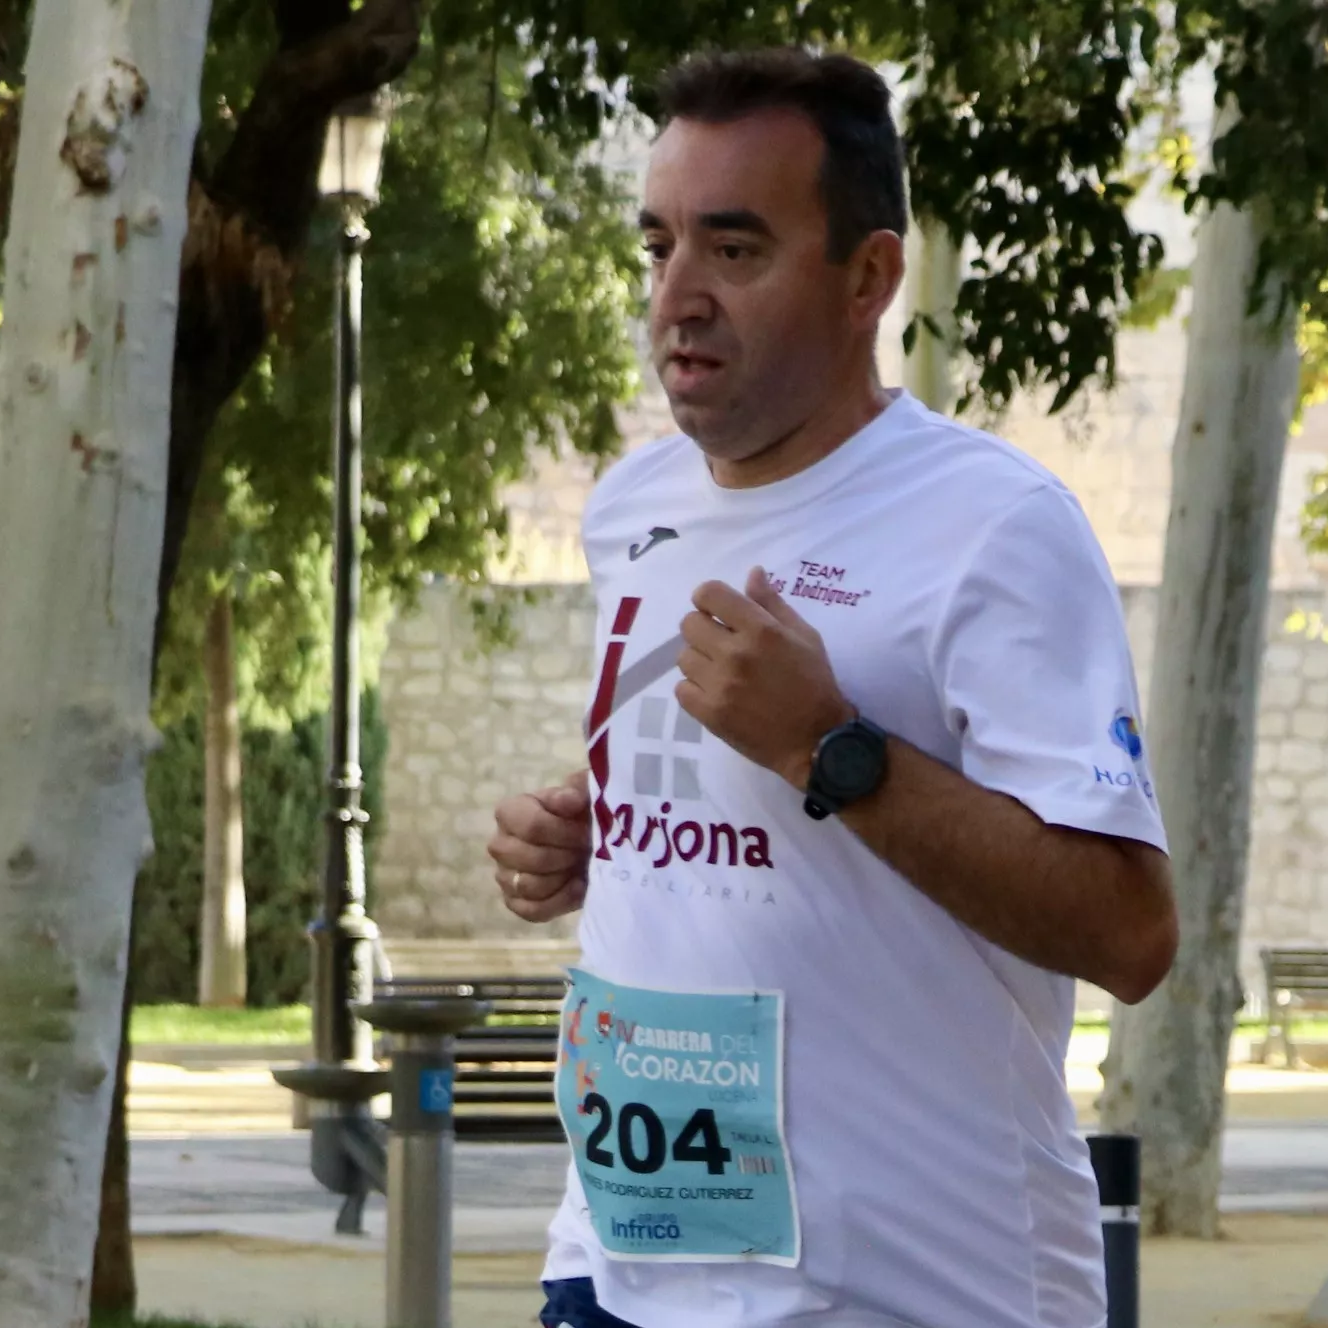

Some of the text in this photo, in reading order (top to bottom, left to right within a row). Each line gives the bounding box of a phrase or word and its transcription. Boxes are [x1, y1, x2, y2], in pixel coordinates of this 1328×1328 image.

[800, 560, 846, 581] TEAM
[634, 1025, 712, 1053] CARRERA
[720, 1034, 758, 1055] DEL
[622, 1051, 760, 1087] CORAZÓN
[583, 1092, 732, 1175] 204
[605, 1181, 675, 1200] RODRIGUEZ
[678, 1187, 754, 1201] GUTIERREZ
